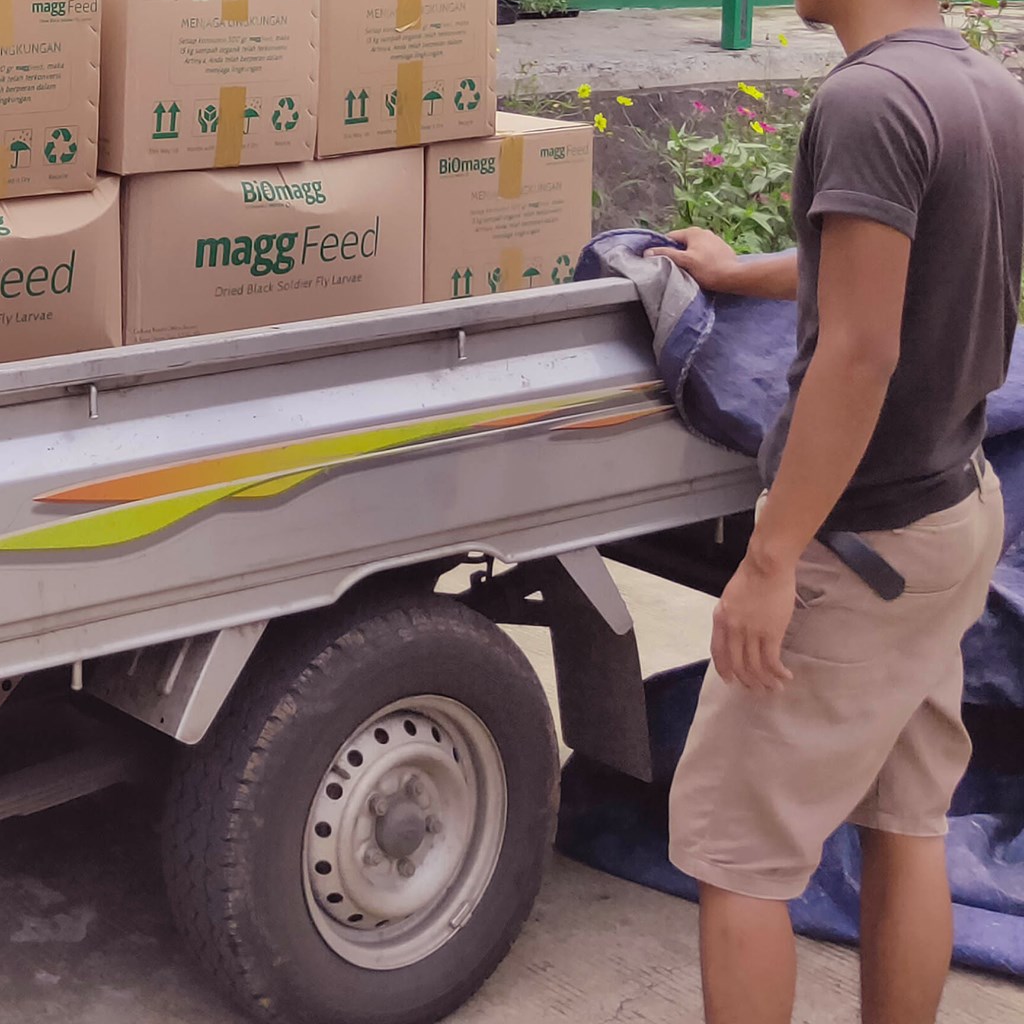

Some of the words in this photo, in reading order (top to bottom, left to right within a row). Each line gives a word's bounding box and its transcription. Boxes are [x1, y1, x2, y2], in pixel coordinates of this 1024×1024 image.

[215, 284, 244, 298] Dried
[247, 282, 274, 295] Black
[277, 279, 312, 292] Soldier
[315, 276, 329, 289] Fly
[331, 273, 363, 287] Larvae
[15, 310, 54, 323] Larvae
